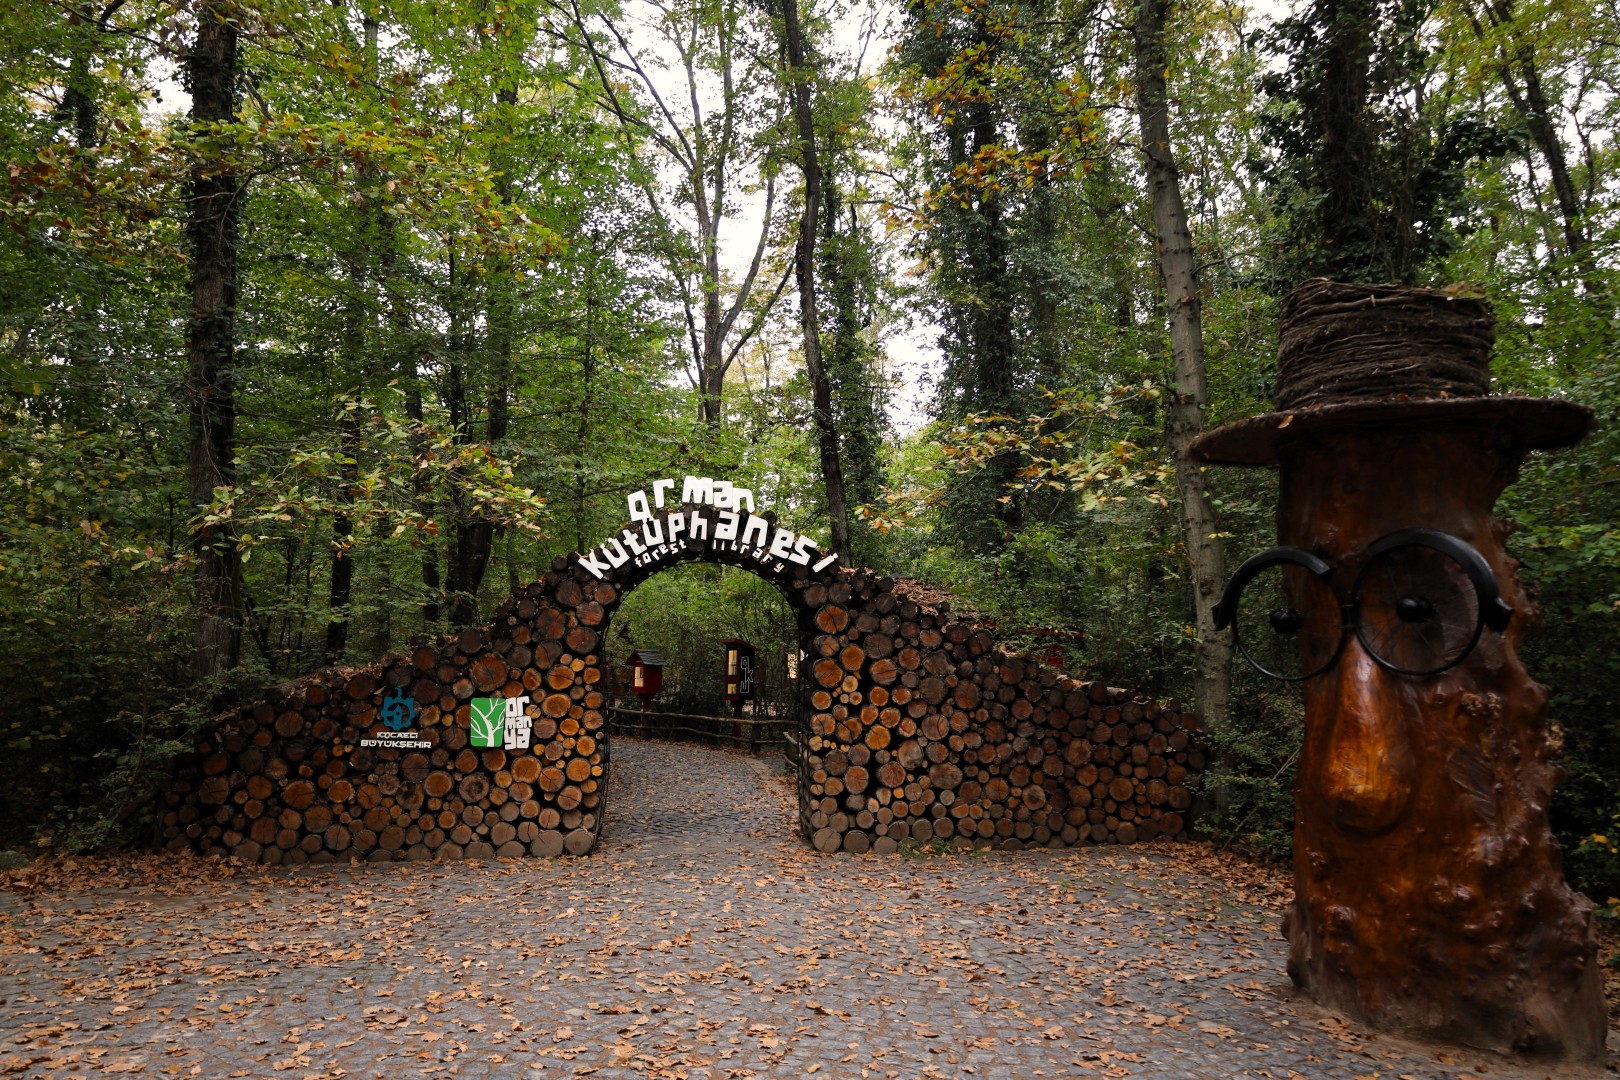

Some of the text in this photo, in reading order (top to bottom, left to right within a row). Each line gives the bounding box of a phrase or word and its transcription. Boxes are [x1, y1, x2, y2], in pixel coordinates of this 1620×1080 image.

[627, 475, 756, 522] orman
[634, 539, 785, 574] forest library
